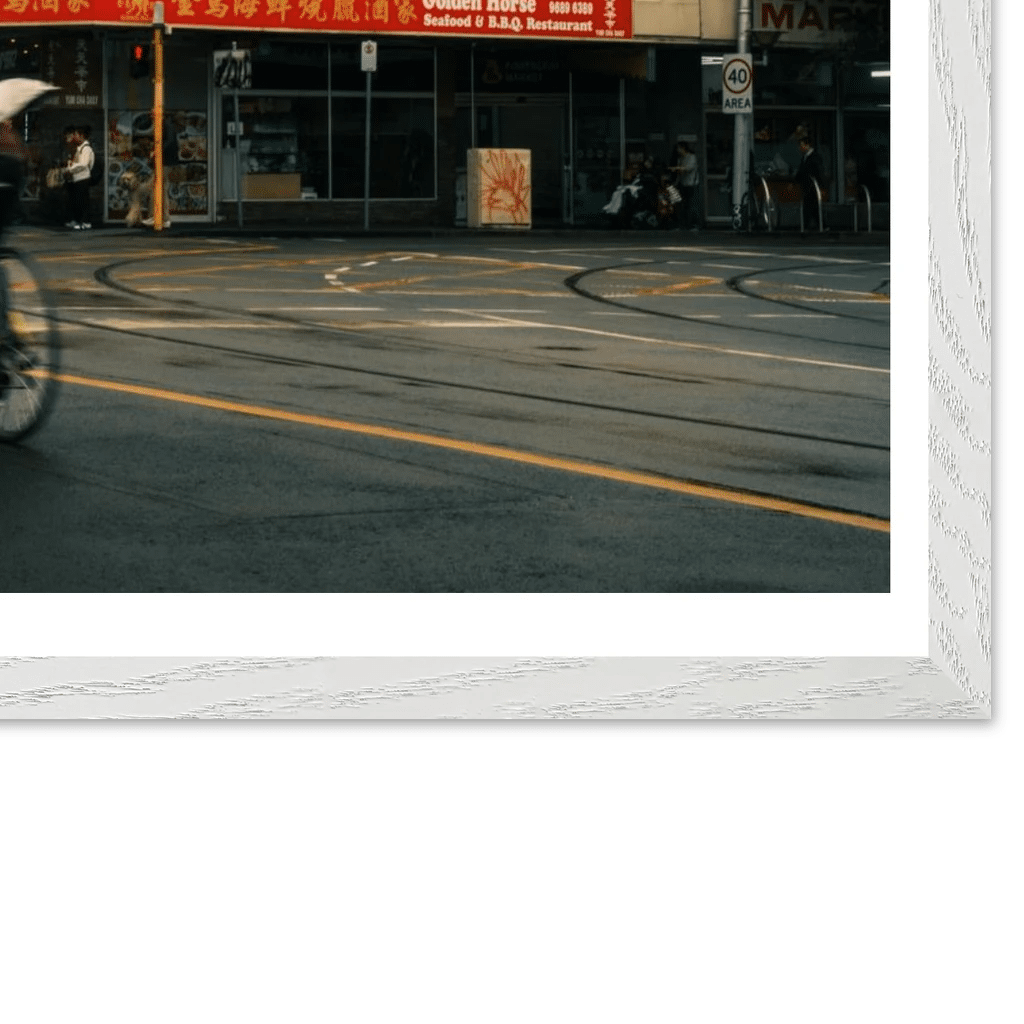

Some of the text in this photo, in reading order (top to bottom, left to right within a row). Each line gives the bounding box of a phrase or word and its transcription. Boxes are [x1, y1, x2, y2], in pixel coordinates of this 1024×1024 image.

[423, 13, 593, 32] Seafood & B.B.Q. Restaurant
[728, 68, 747, 84] 40
[725, 98, 751, 109] AREA
